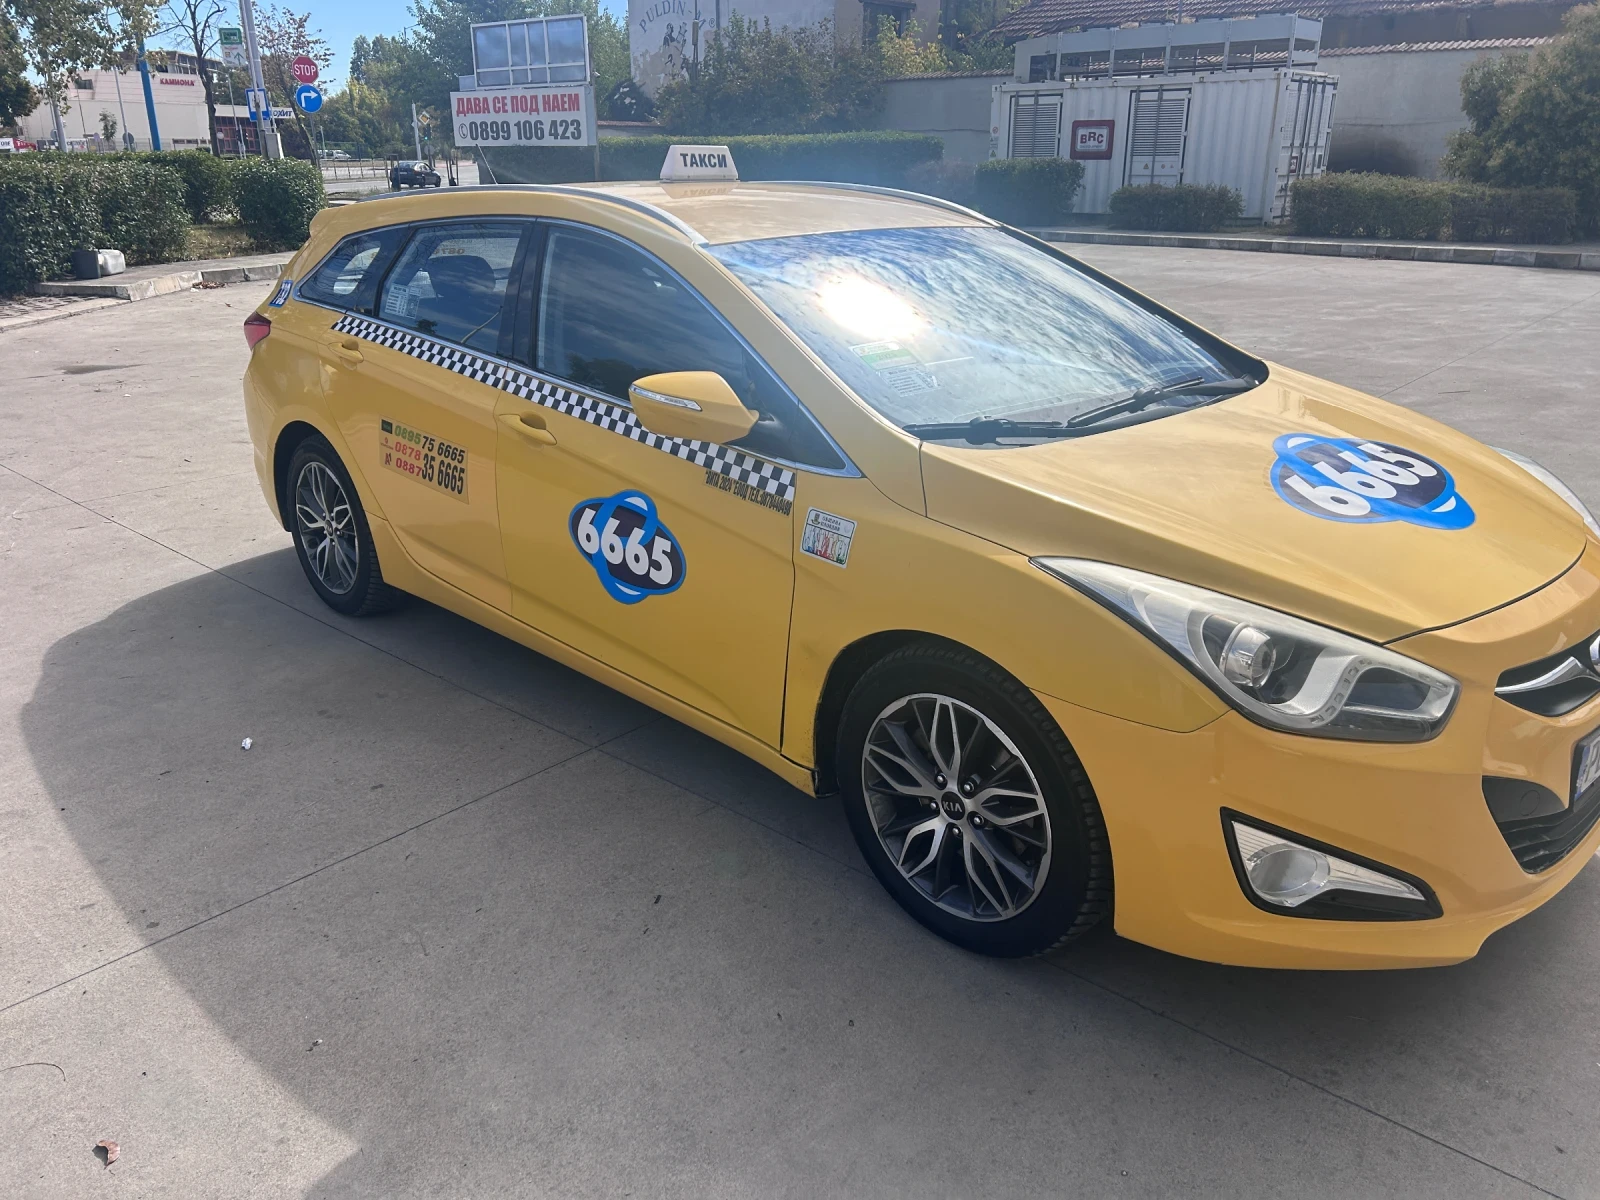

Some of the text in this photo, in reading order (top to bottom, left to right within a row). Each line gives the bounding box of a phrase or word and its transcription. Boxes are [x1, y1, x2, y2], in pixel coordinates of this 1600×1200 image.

[294, 64, 316, 76] STOP
[456, 93, 580, 117] ДАВА СЕ ПОД НАЕМ
[469, 119, 581, 140] 0899 106 423
[1080, 132, 1104, 144] BRC
[680, 153, 728, 168] ТАКСИ
[394, 425, 465, 464] 0895 75 6665
[394, 441, 465, 494] 0878 35 6665
[395, 457, 422, 476] 0887
[1284, 443, 1438, 516] 6665
[577, 508, 673, 585] 6665
[942, 801, 962, 812] KIA
